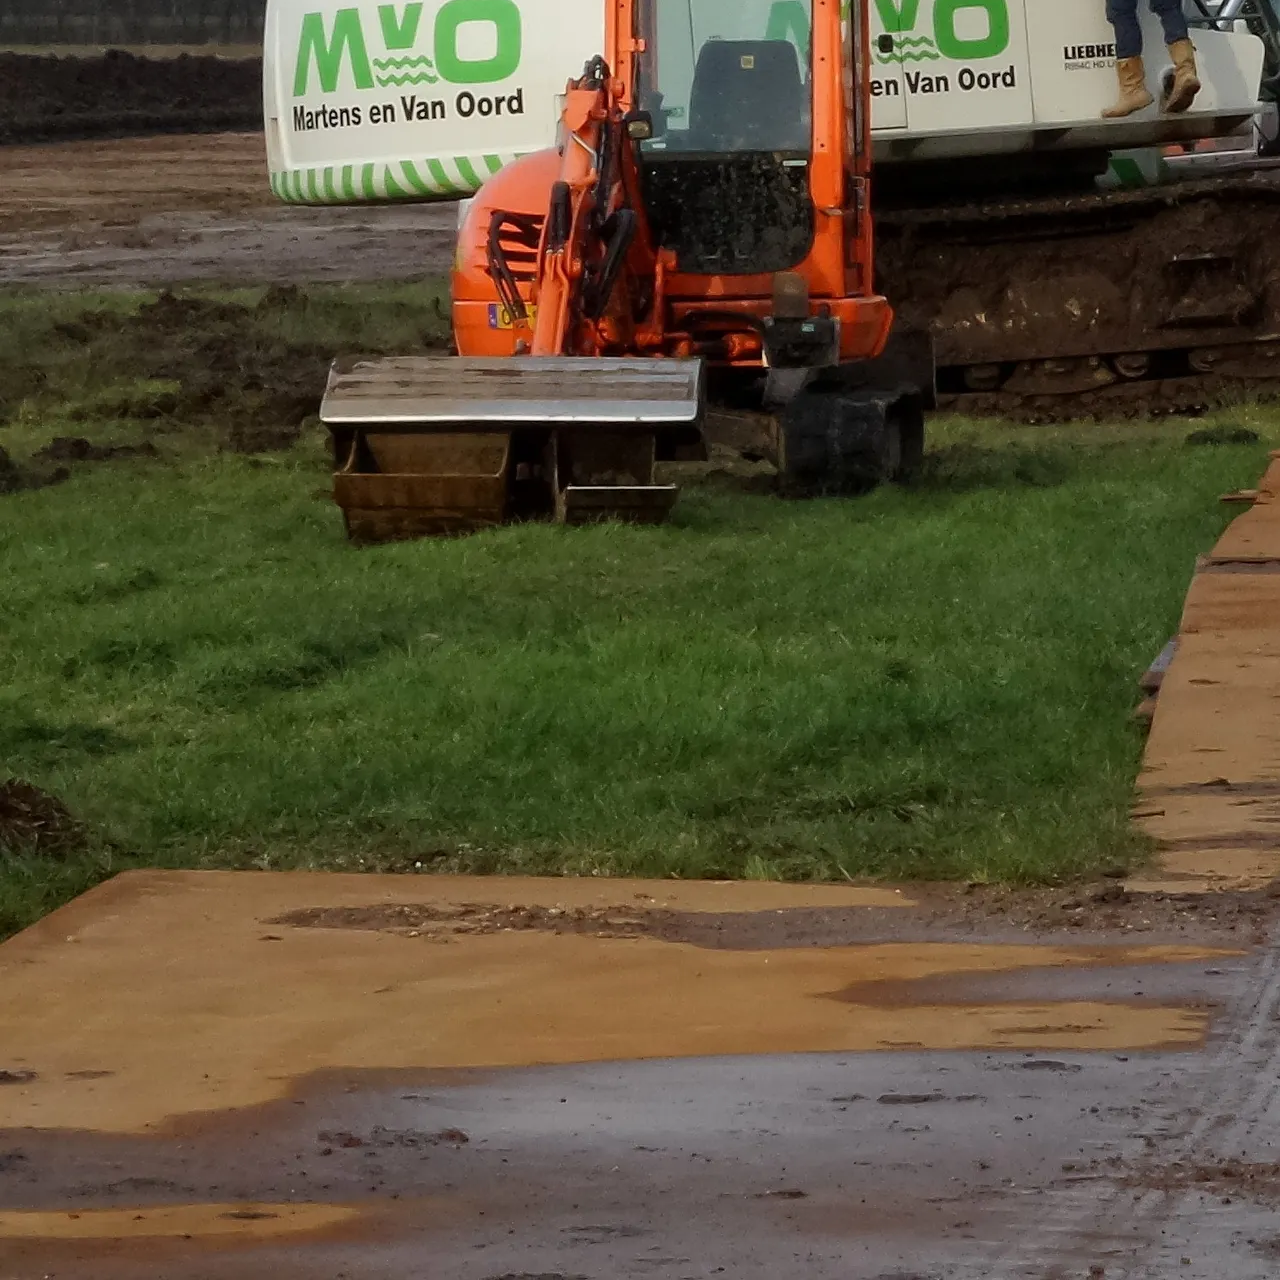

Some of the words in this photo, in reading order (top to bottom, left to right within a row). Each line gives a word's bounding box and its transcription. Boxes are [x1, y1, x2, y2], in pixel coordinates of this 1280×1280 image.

[1064, 43, 1117, 60] LIEBHE
[905, 71, 949, 94] Van
[958, 65, 1016, 91] Oord
[293, 103, 362, 132] Martens
[369, 103, 396, 124] en
[400, 95, 445, 121] Van
[455, 88, 524, 118] Oord
